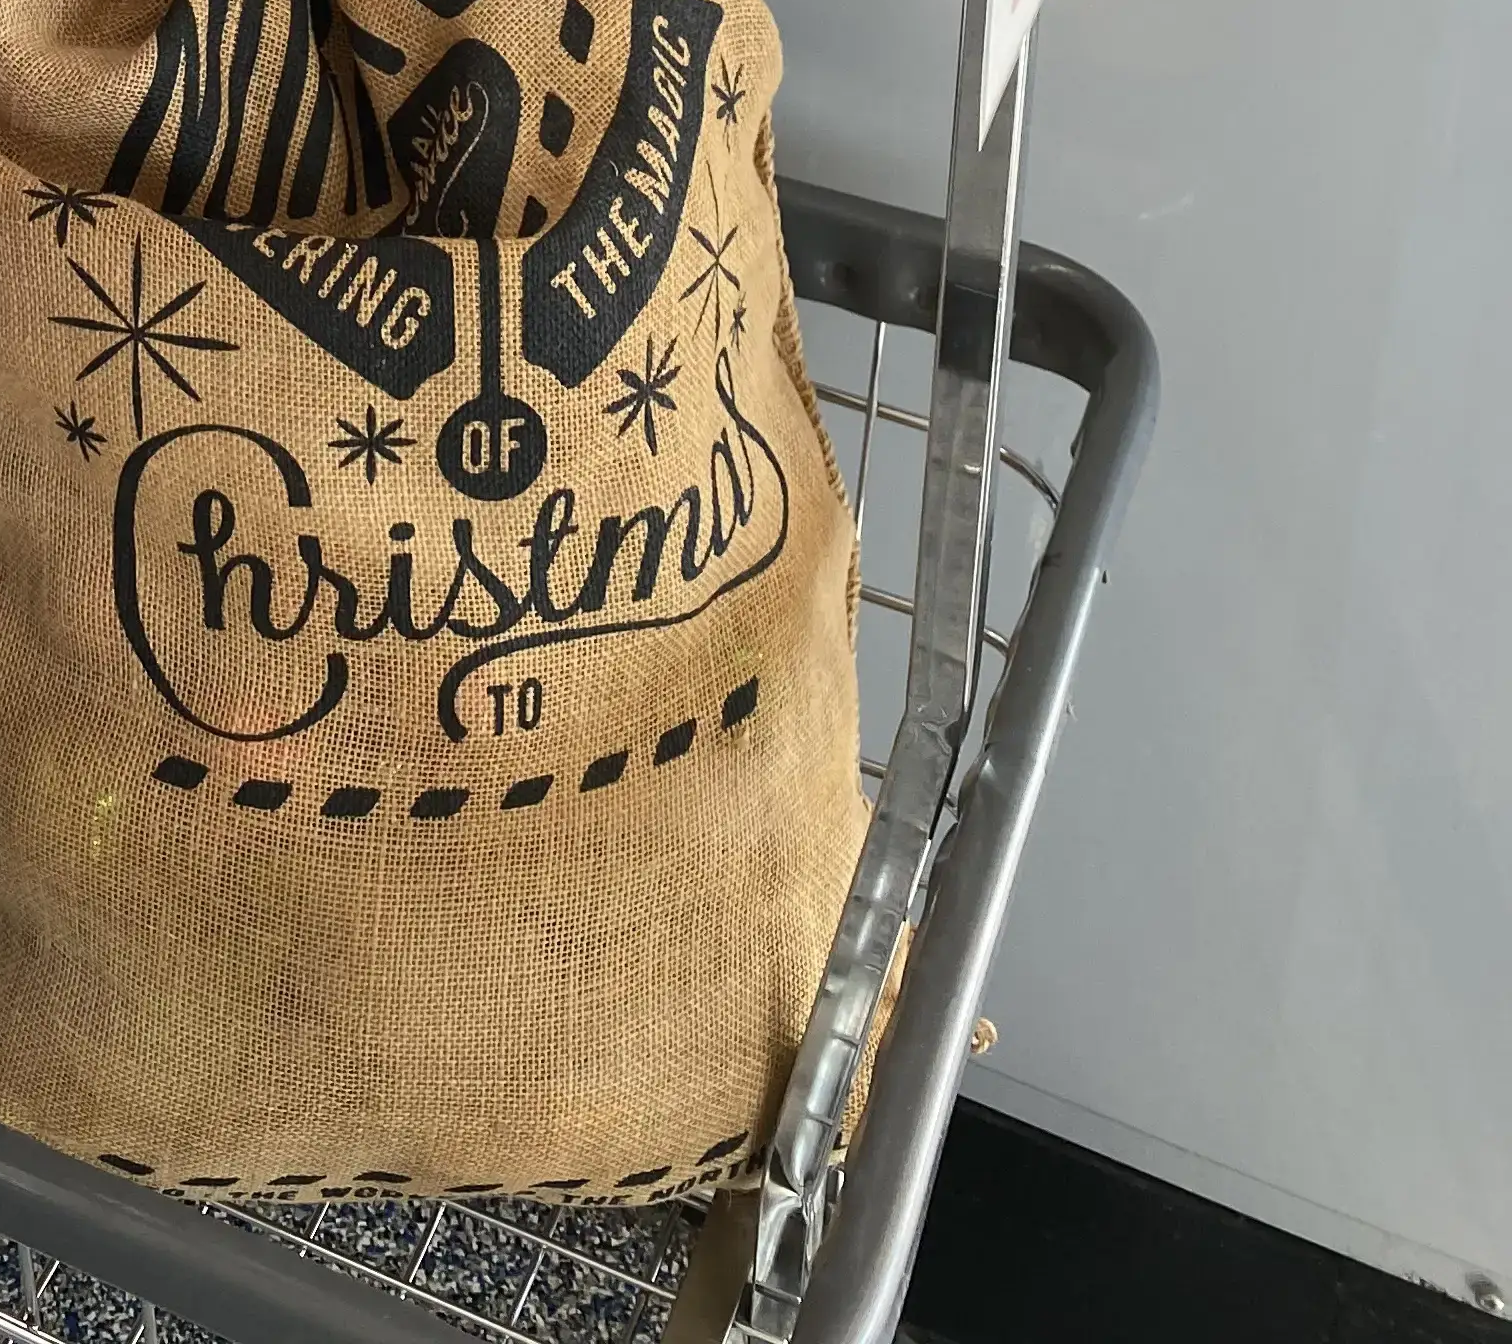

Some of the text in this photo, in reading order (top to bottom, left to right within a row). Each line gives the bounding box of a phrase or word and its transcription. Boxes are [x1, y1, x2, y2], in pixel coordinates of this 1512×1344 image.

[226, 224, 431, 350] ERING
[551, 197, 653, 318] THE
[460, 418, 526, 475] OF
[113, 348, 788, 742] Christmas
[486, 676, 542, 737] TO
